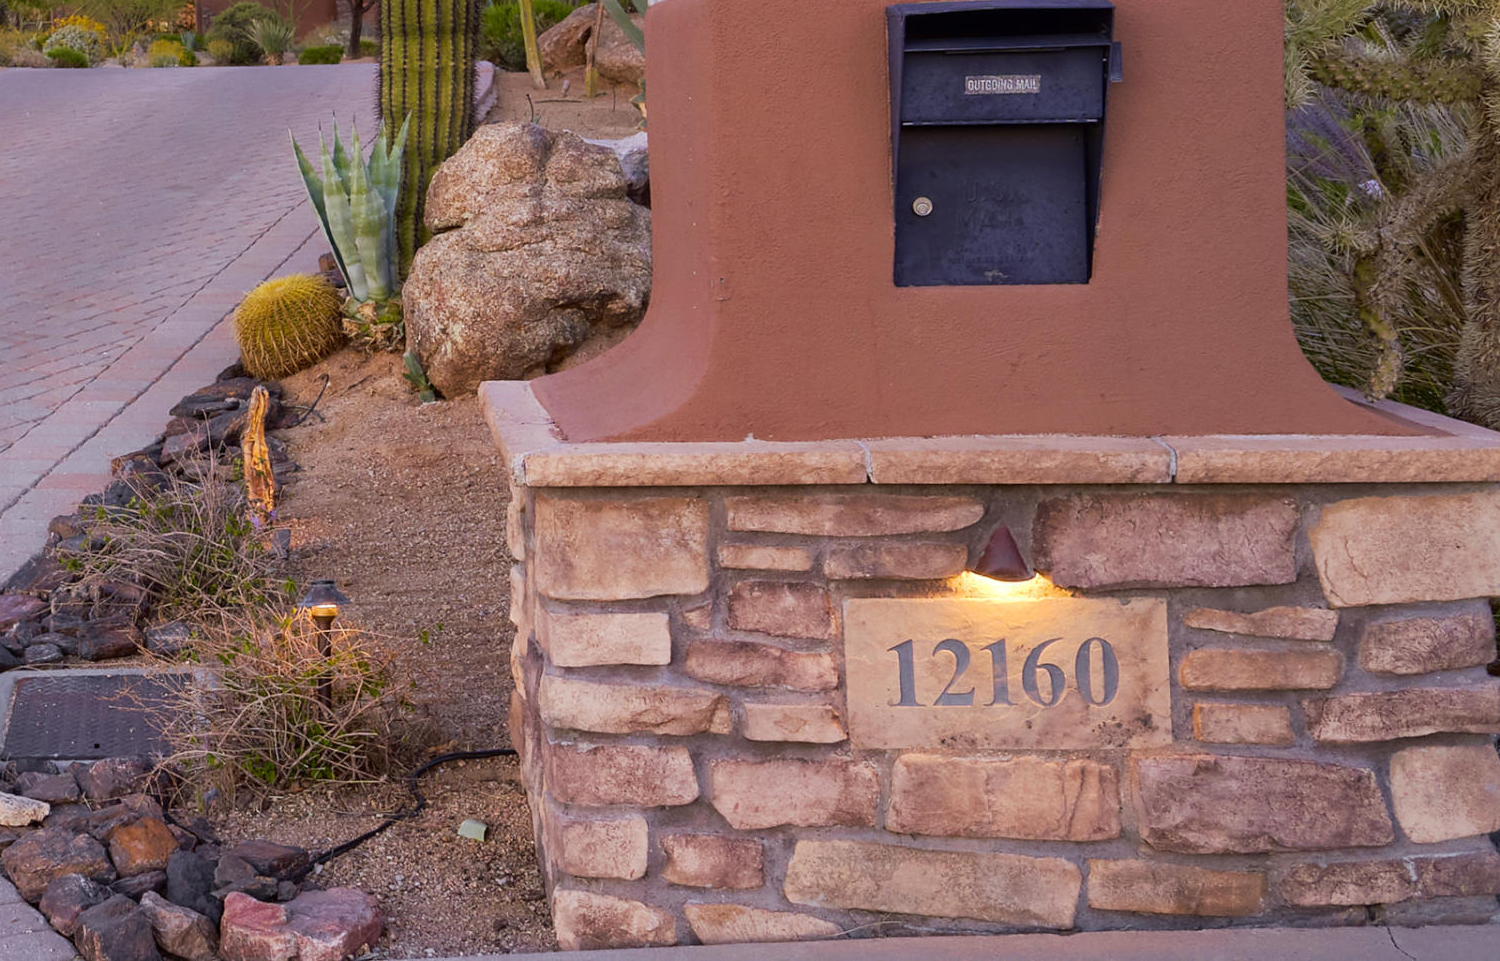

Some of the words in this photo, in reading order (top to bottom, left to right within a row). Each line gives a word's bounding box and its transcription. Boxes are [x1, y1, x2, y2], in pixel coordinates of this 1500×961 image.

[967, 79, 1013, 91] OUTGOING
[1015, 79, 1037, 90] MAIL
[887, 637, 1119, 707] 12160
